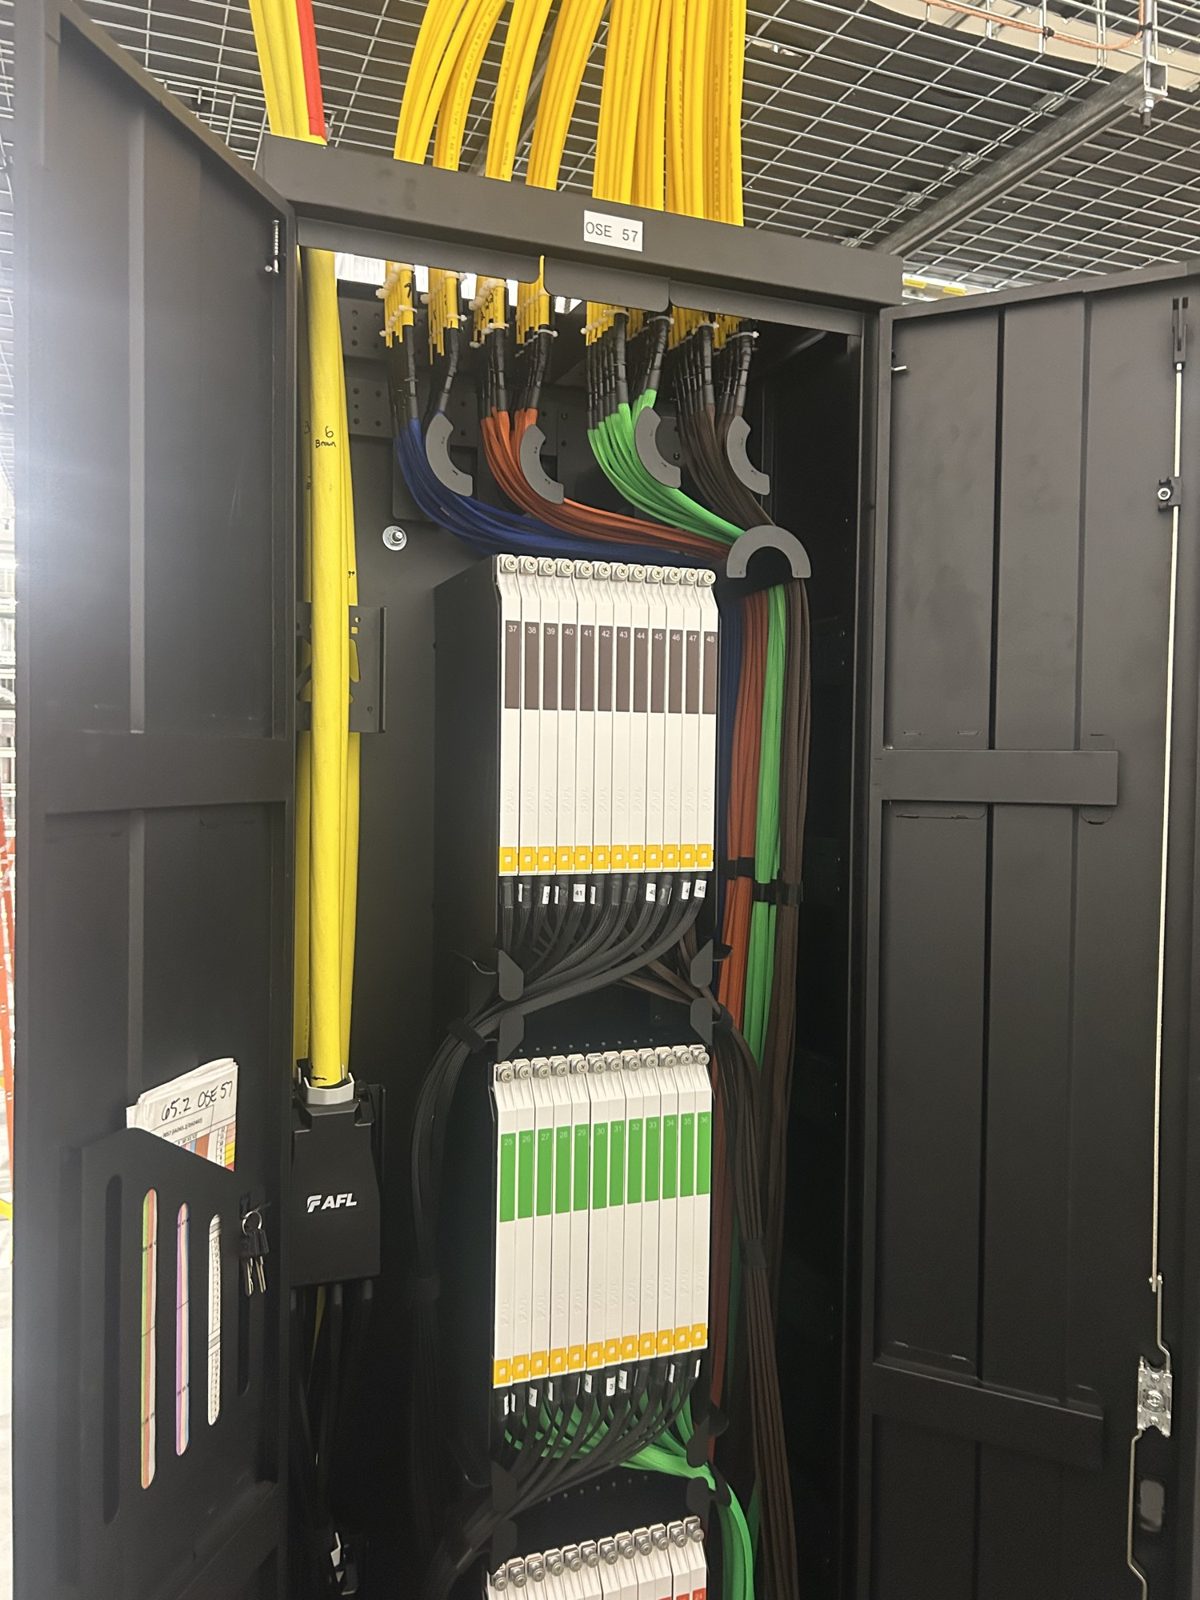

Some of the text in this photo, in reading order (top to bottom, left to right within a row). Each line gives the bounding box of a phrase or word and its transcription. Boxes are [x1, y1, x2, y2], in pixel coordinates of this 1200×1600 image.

[585, 221, 639, 243] OSE 57
[325, 425, 334, 438] 6
[508, 625, 518, 633] 37
[527, 626, 537, 634] 38
[564, 628, 574, 636] 40
[583, 629, 592, 637] 41
[601, 630, 611, 638] 42
[619, 631, 628, 639] 43
[636, 632, 646, 640] 44
[654, 632, 664, 640] 45
[672, 633, 681, 641] 46
[689, 634, 697, 642] 47
[161, 1081, 233, 1121] 65.2 OSE 57
[596, 1127, 605, 1136] 30
[613, 1125, 622, 1133] 31
[541, 1133, 550, 1141] 27
[321, 1193, 357, 1210] AFL
